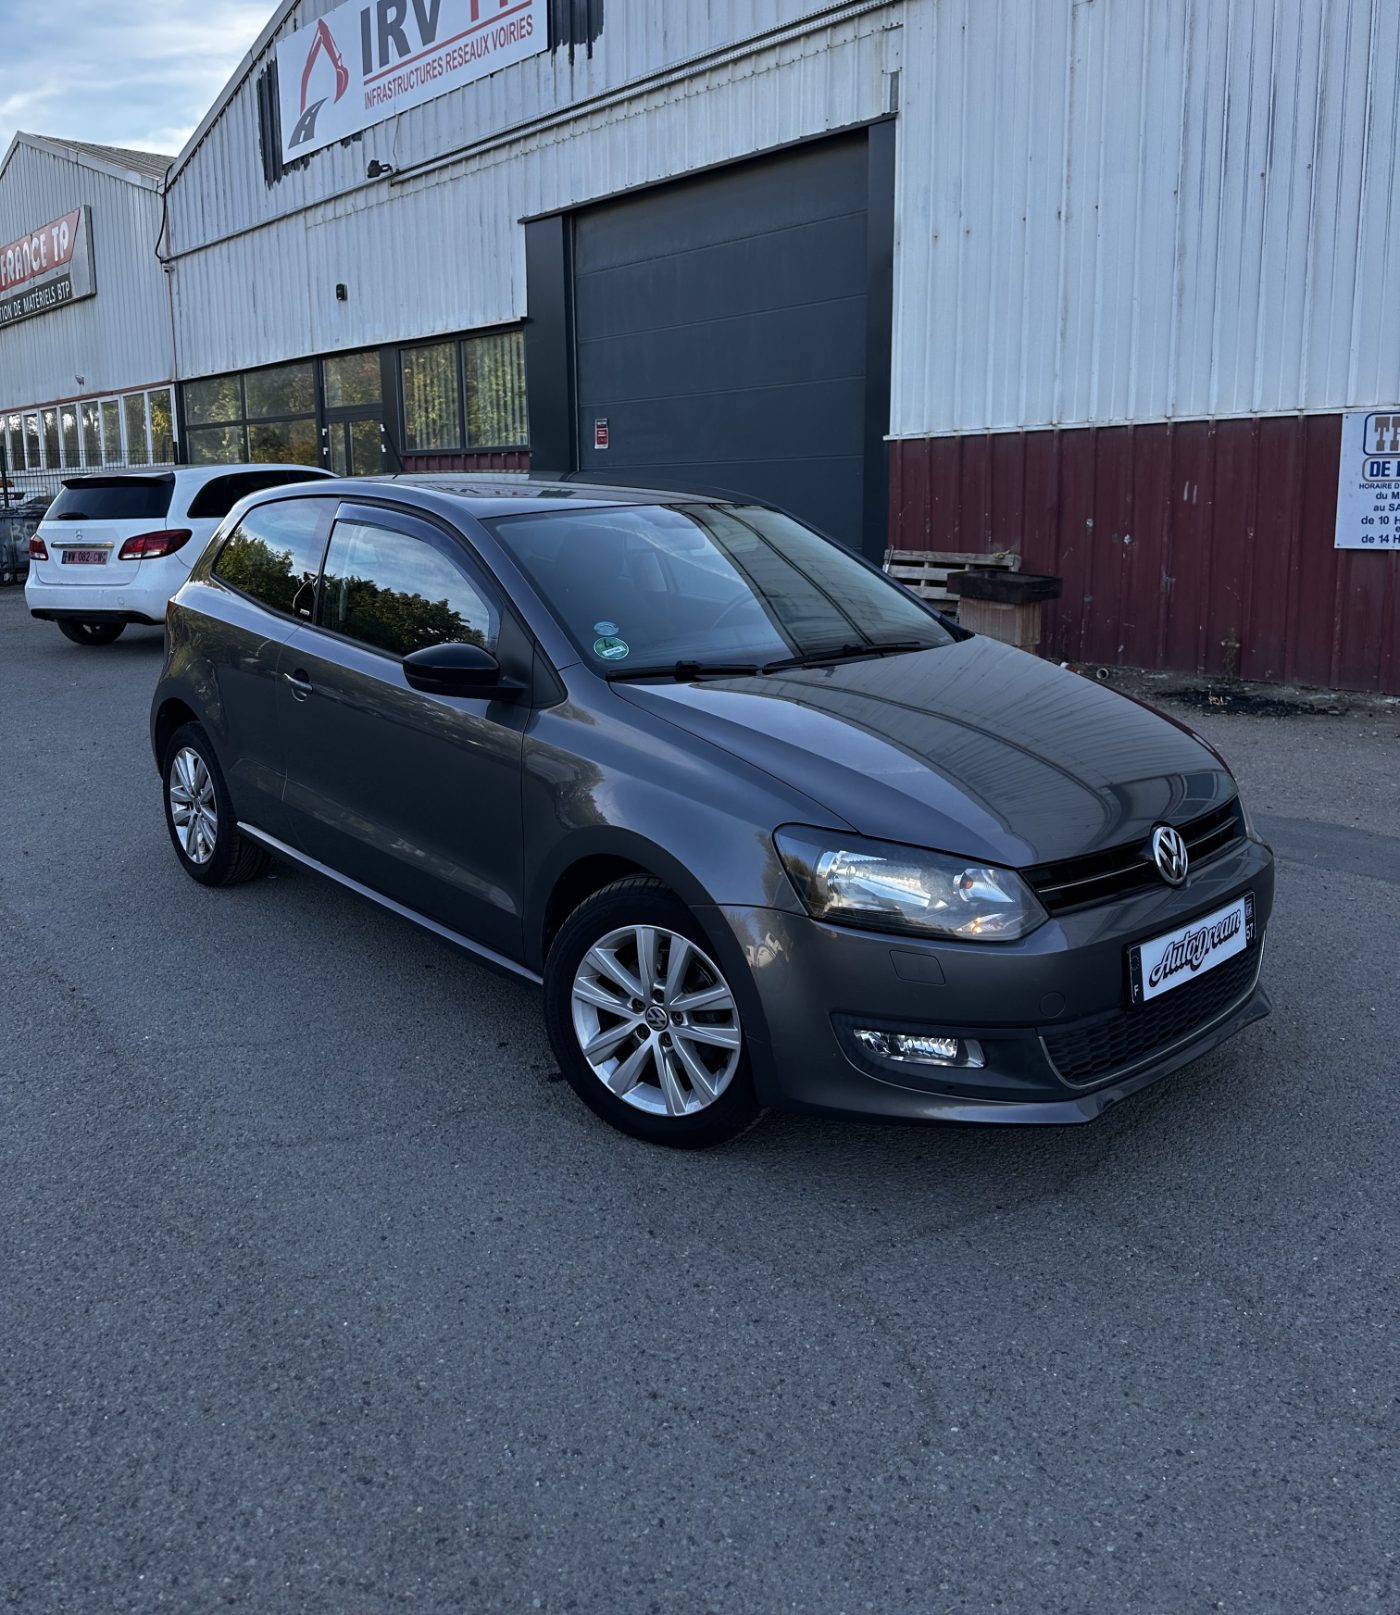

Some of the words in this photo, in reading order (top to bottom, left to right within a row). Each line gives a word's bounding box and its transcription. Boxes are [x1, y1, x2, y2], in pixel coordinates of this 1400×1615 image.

[360, 0, 441, 76] IRV
[364, 56, 444, 110] INFRASTRUCTURES
[445, 33, 490, 73] RESEAUX
[491, 14, 533, 49] VOIRIES
[0, 233, 48, 287] FRANCE
[52, 220, 69, 262] TP
[13, 300, 22, 316] DE
[57, 280, 70, 300] BTP
[1369, 461, 1391, 477] DE
[1376, 491, 1388, 500] du
[1361, 516, 1375, 525] de
[1379, 516, 1390, 525] 10
[1361, 534, 1375, 543] de
[1379, 534, 1390, 543] 14
[1133, 984, 1139, 997] F
